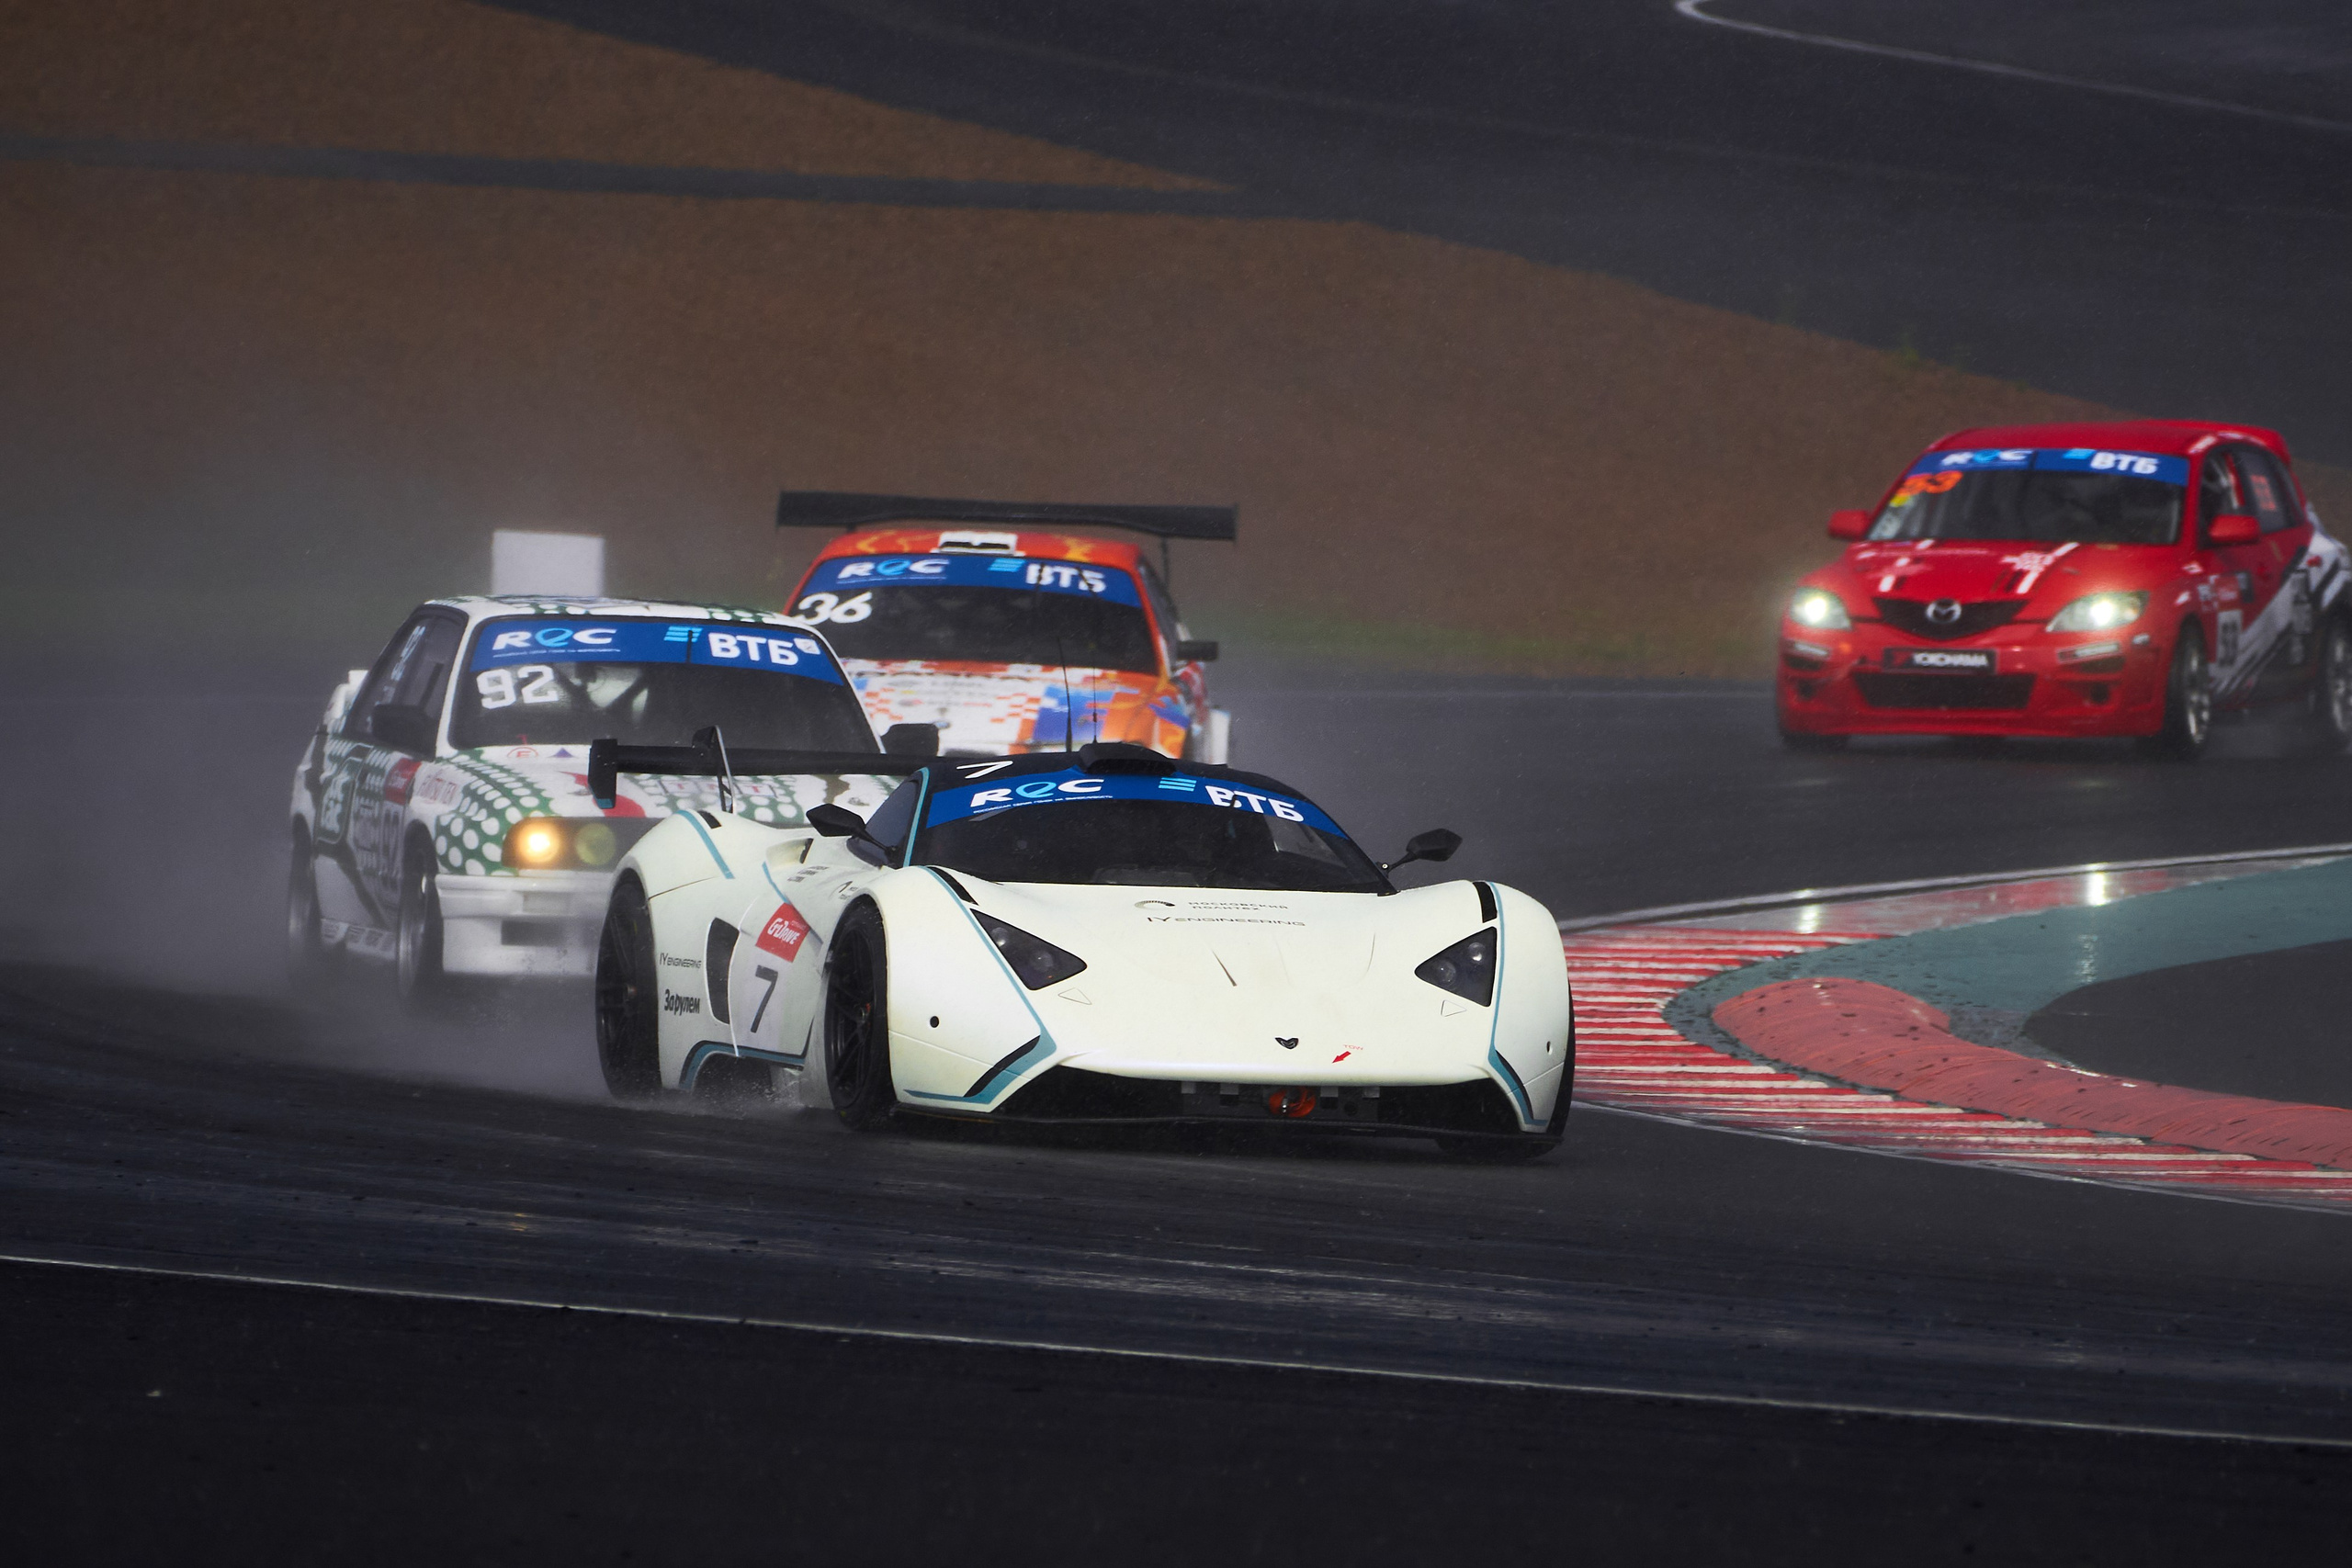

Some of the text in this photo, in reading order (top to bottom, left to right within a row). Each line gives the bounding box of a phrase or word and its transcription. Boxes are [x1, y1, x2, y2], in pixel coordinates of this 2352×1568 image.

[2090, 451, 2159, 474] ВТБ
[1025, 563, 1106, 593] ВТБ
[794, 591, 873, 626] 36
[708, 632, 799, 666] ВТБ
[476, 665, 559, 709] 92
[1204, 785, 1305, 822] ВТБ
[750, 964, 779, 1033] 7
